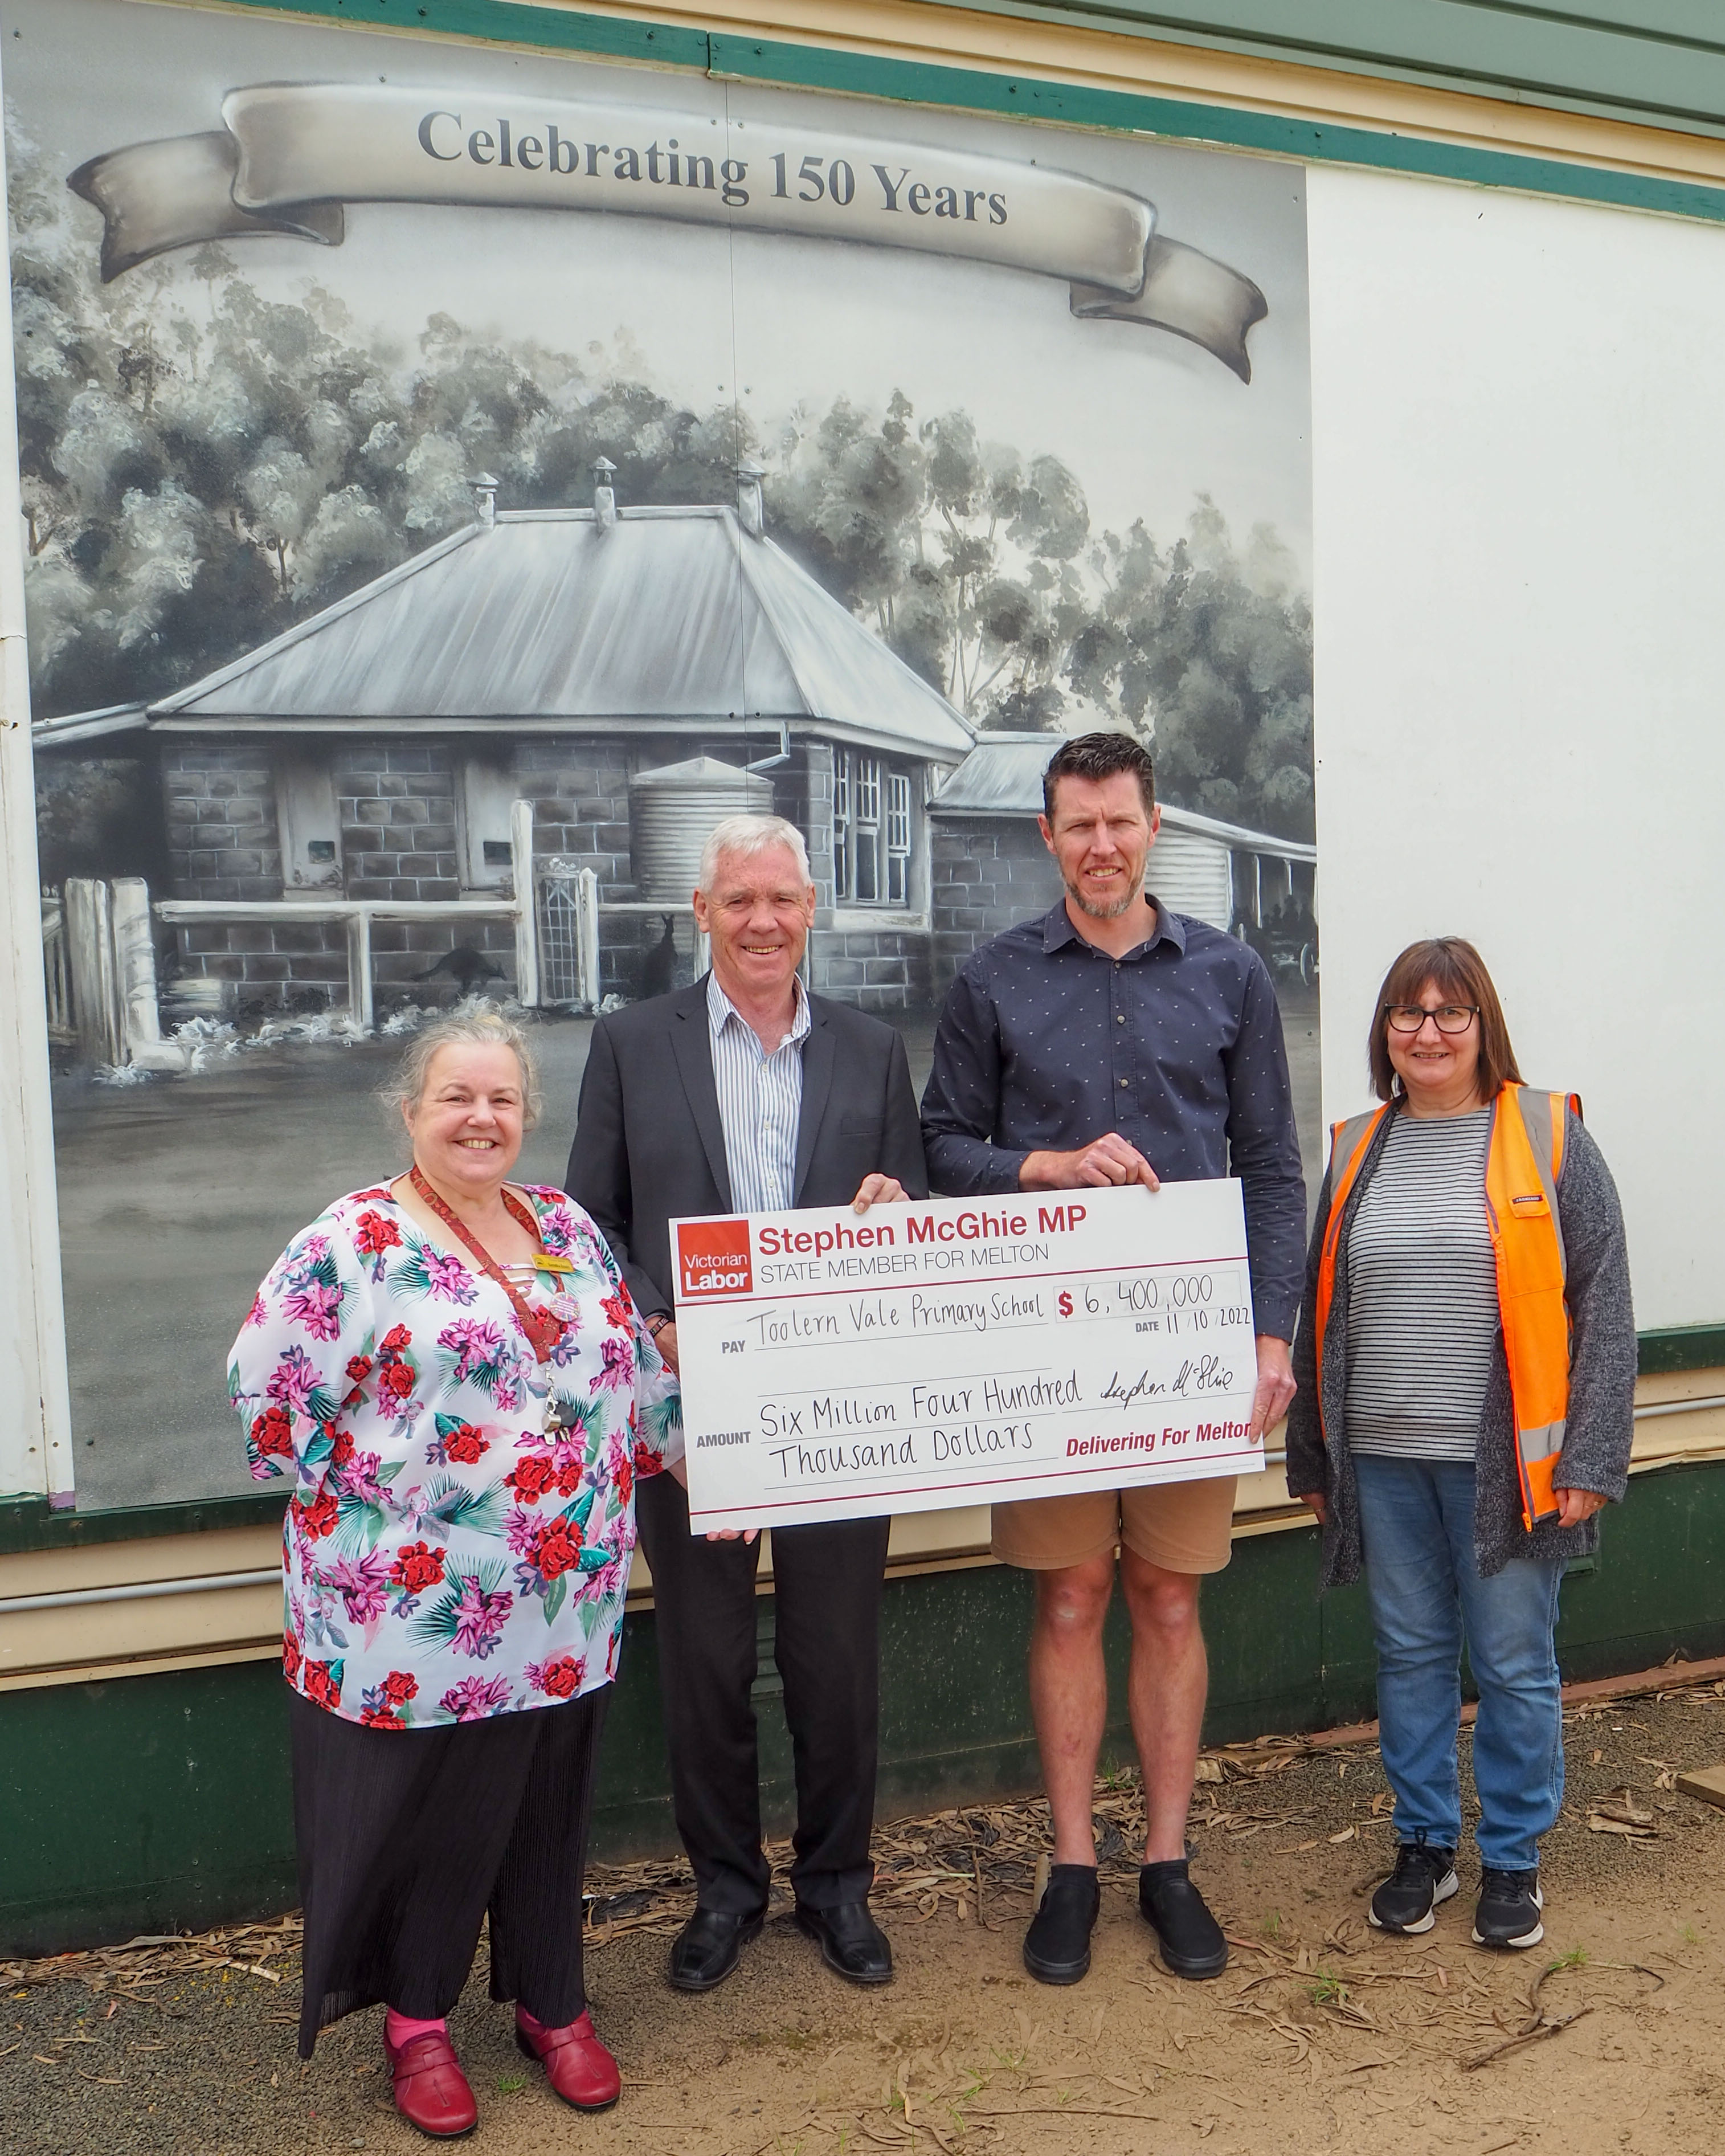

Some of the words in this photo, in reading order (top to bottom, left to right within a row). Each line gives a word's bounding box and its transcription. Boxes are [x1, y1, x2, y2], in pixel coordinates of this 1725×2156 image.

[418, 111, 751, 207] Celebrating
[769, 153, 856, 206] 150
[869, 164, 1008, 226] Years
[759, 1223, 895, 1257] Stephen
[907, 1210, 1027, 1243] McGhie
[1037, 1204, 1087, 1234] MP
[685, 1252, 748, 1269] Victorian
[760, 1262, 821, 1284] STATE
[828, 1255, 917, 1279] MEMBER
[924, 1250, 965, 1272] FOR
[971, 1243, 1049, 1267] MELTON
[685, 1270, 748, 1291] Labor
[747, 1309, 840, 1345] Toolern
[849, 1298, 900, 1333] Vale
[911, 1293, 987, 1331] Primary
[991, 1293, 1044, 1321] School
[1058, 1291, 1073, 1318] $
[1135, 1321, 1160, 1333] DATE
[721, 1341, 746, 1354] PAY
[761, 1403, 802, 1436] Six
[813, 1396, 897, 1430] Million
[913, 1386, 972, 1418] Four
[984, 1369, 1083, 1414] Hundred
[696, 1431, 751, 1448] AMOUNT
[769, 1434, 917, 1478] Thousand
[934, 1422, 1033, 1461] Dollars
[1066, 1432, 1156, 1457] Delivering
[1162, 1427, 1191, 1446] For
